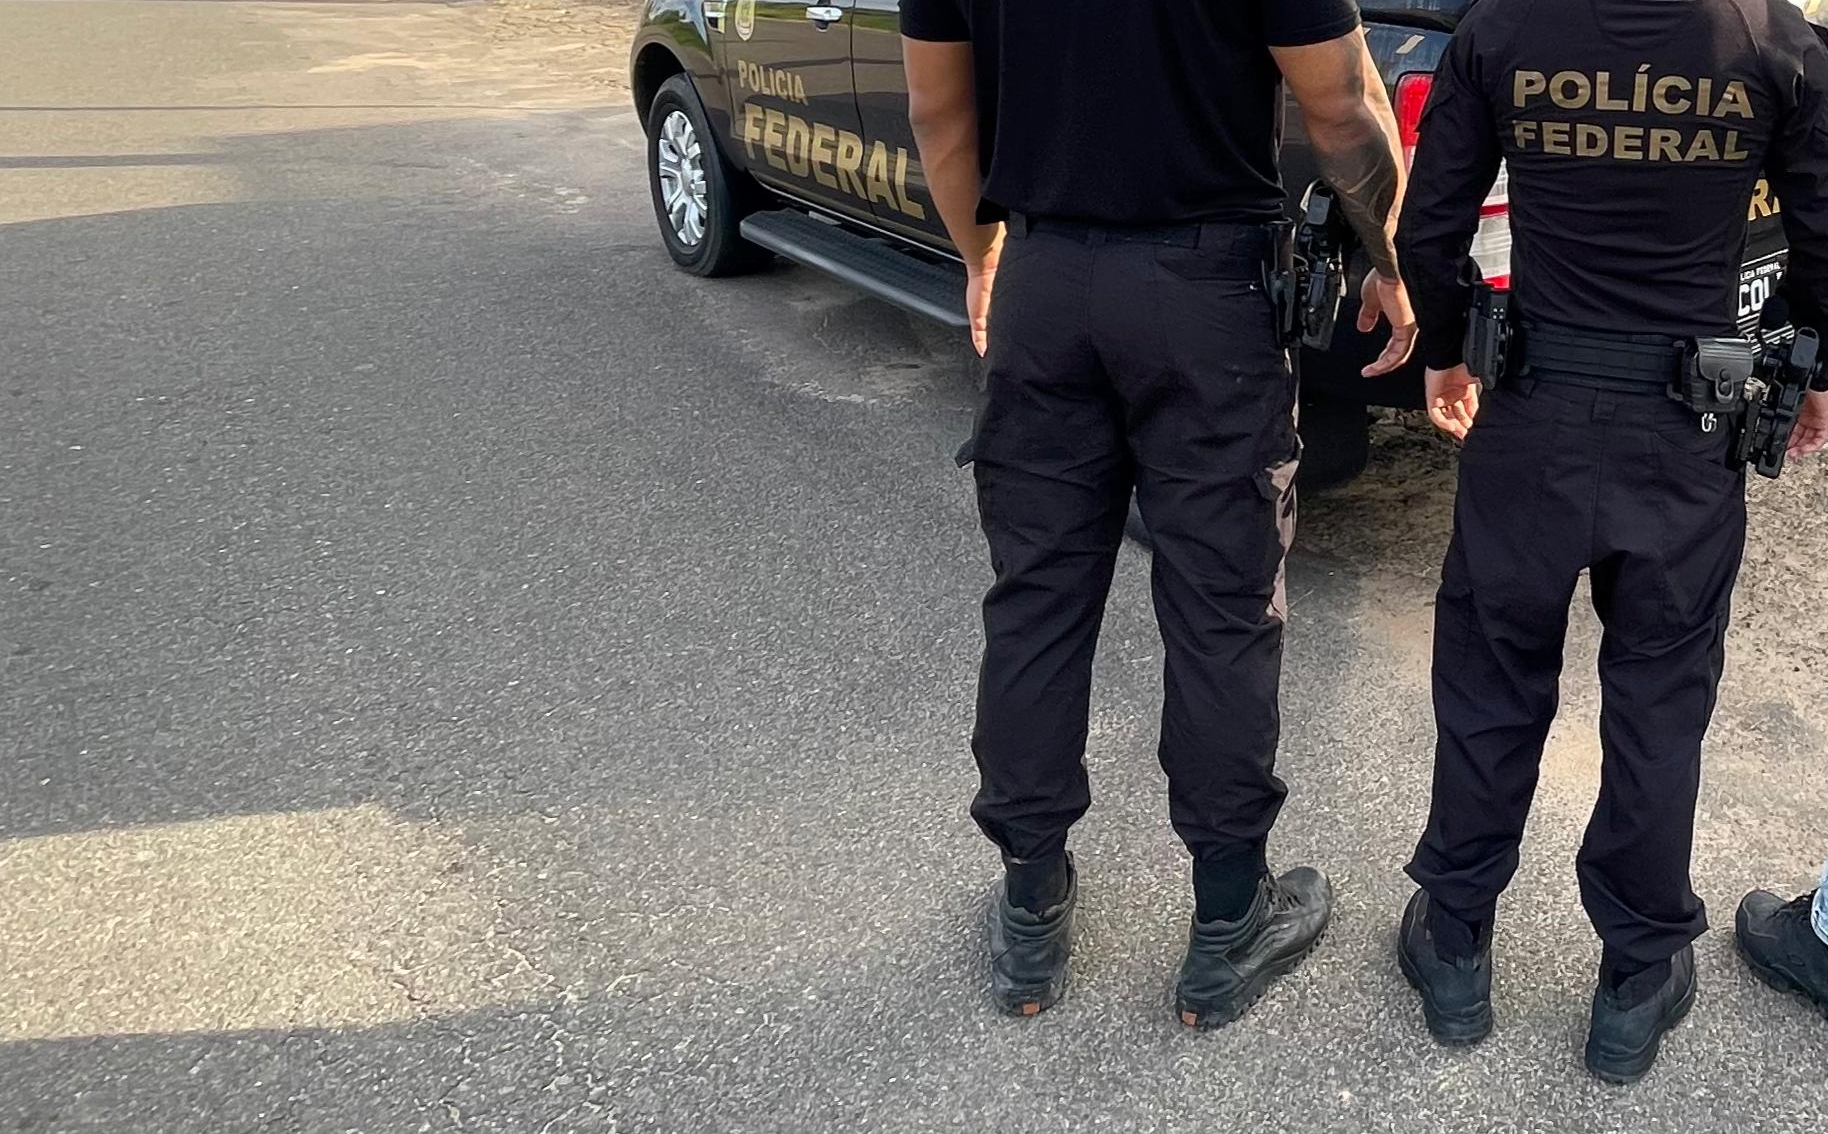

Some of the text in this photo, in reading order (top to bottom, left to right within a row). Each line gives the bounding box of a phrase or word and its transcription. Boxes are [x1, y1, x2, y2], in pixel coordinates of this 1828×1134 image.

[1513, 64, 1755, 119] POLÍCIA
[744, 102, 926, 221] FEDERAL
[1512, 119, 1749, 162] FEDERAL
